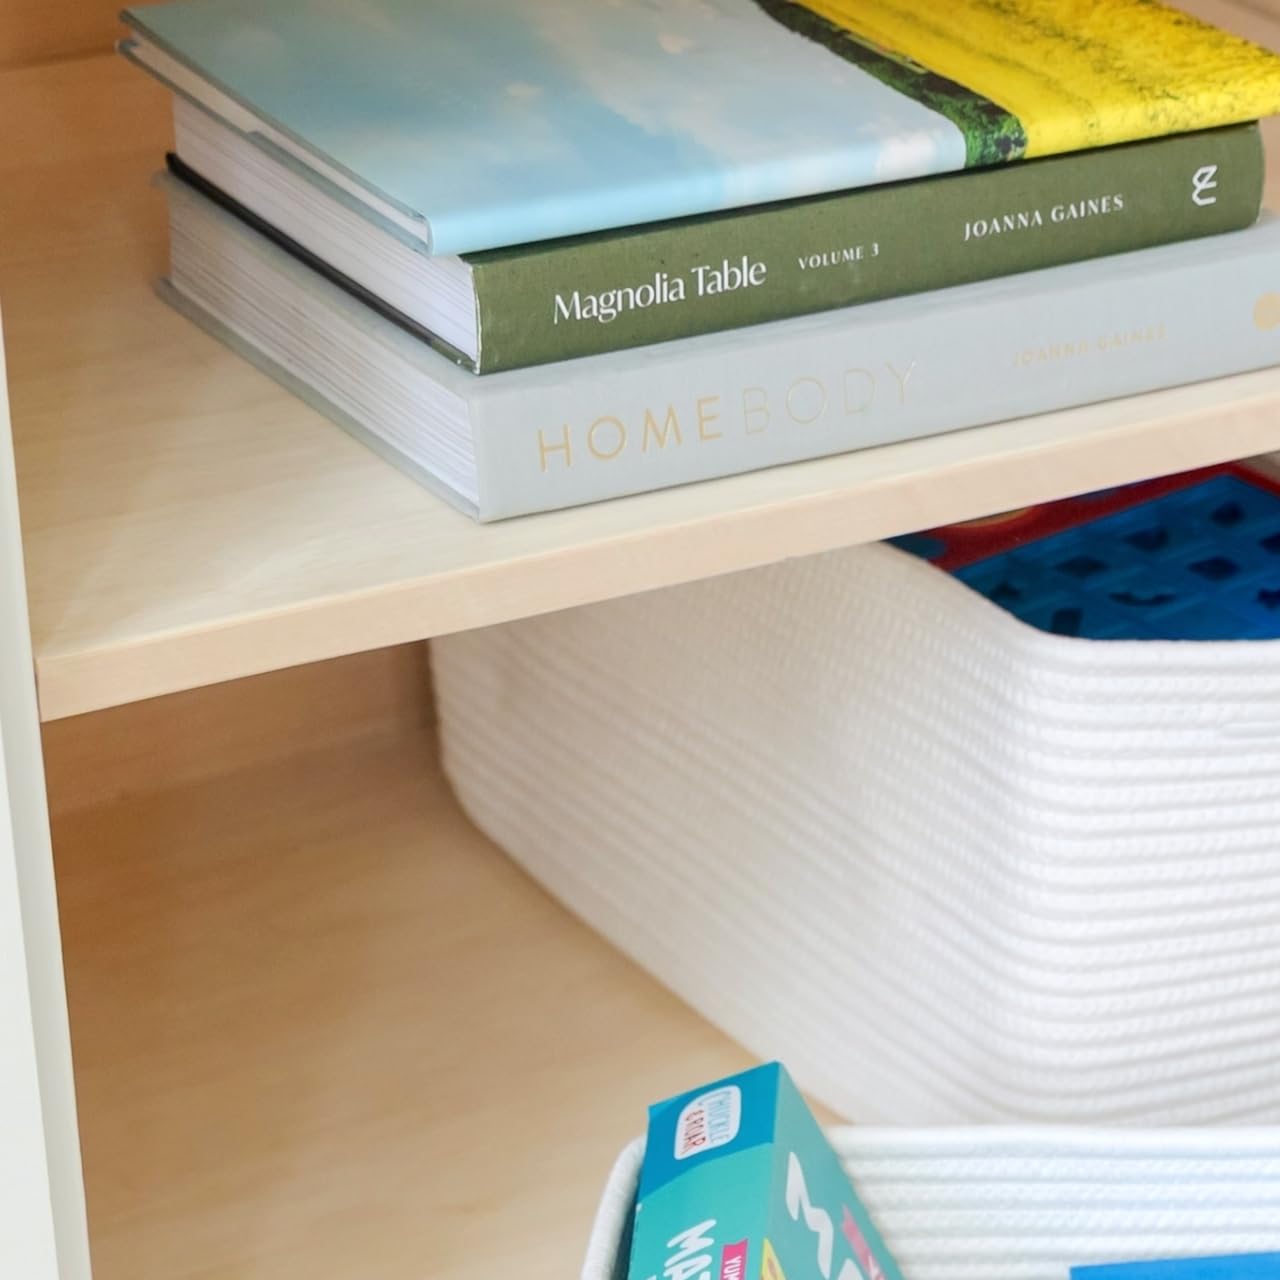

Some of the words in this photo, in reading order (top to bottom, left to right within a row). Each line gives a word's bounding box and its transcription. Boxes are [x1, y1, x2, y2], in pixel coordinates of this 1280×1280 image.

[963, 210, 1043, 241] JOANNA
[1050, 193, 1125, 223] GAINES
[797, 246, 865, 270] VOLUME
[871, 243, 880, 257] 3
[552, 273, 686, 325] Magnolia
[691, 255, 768, 297] Table
[537, 360, 917, 473] HOMEBODY
